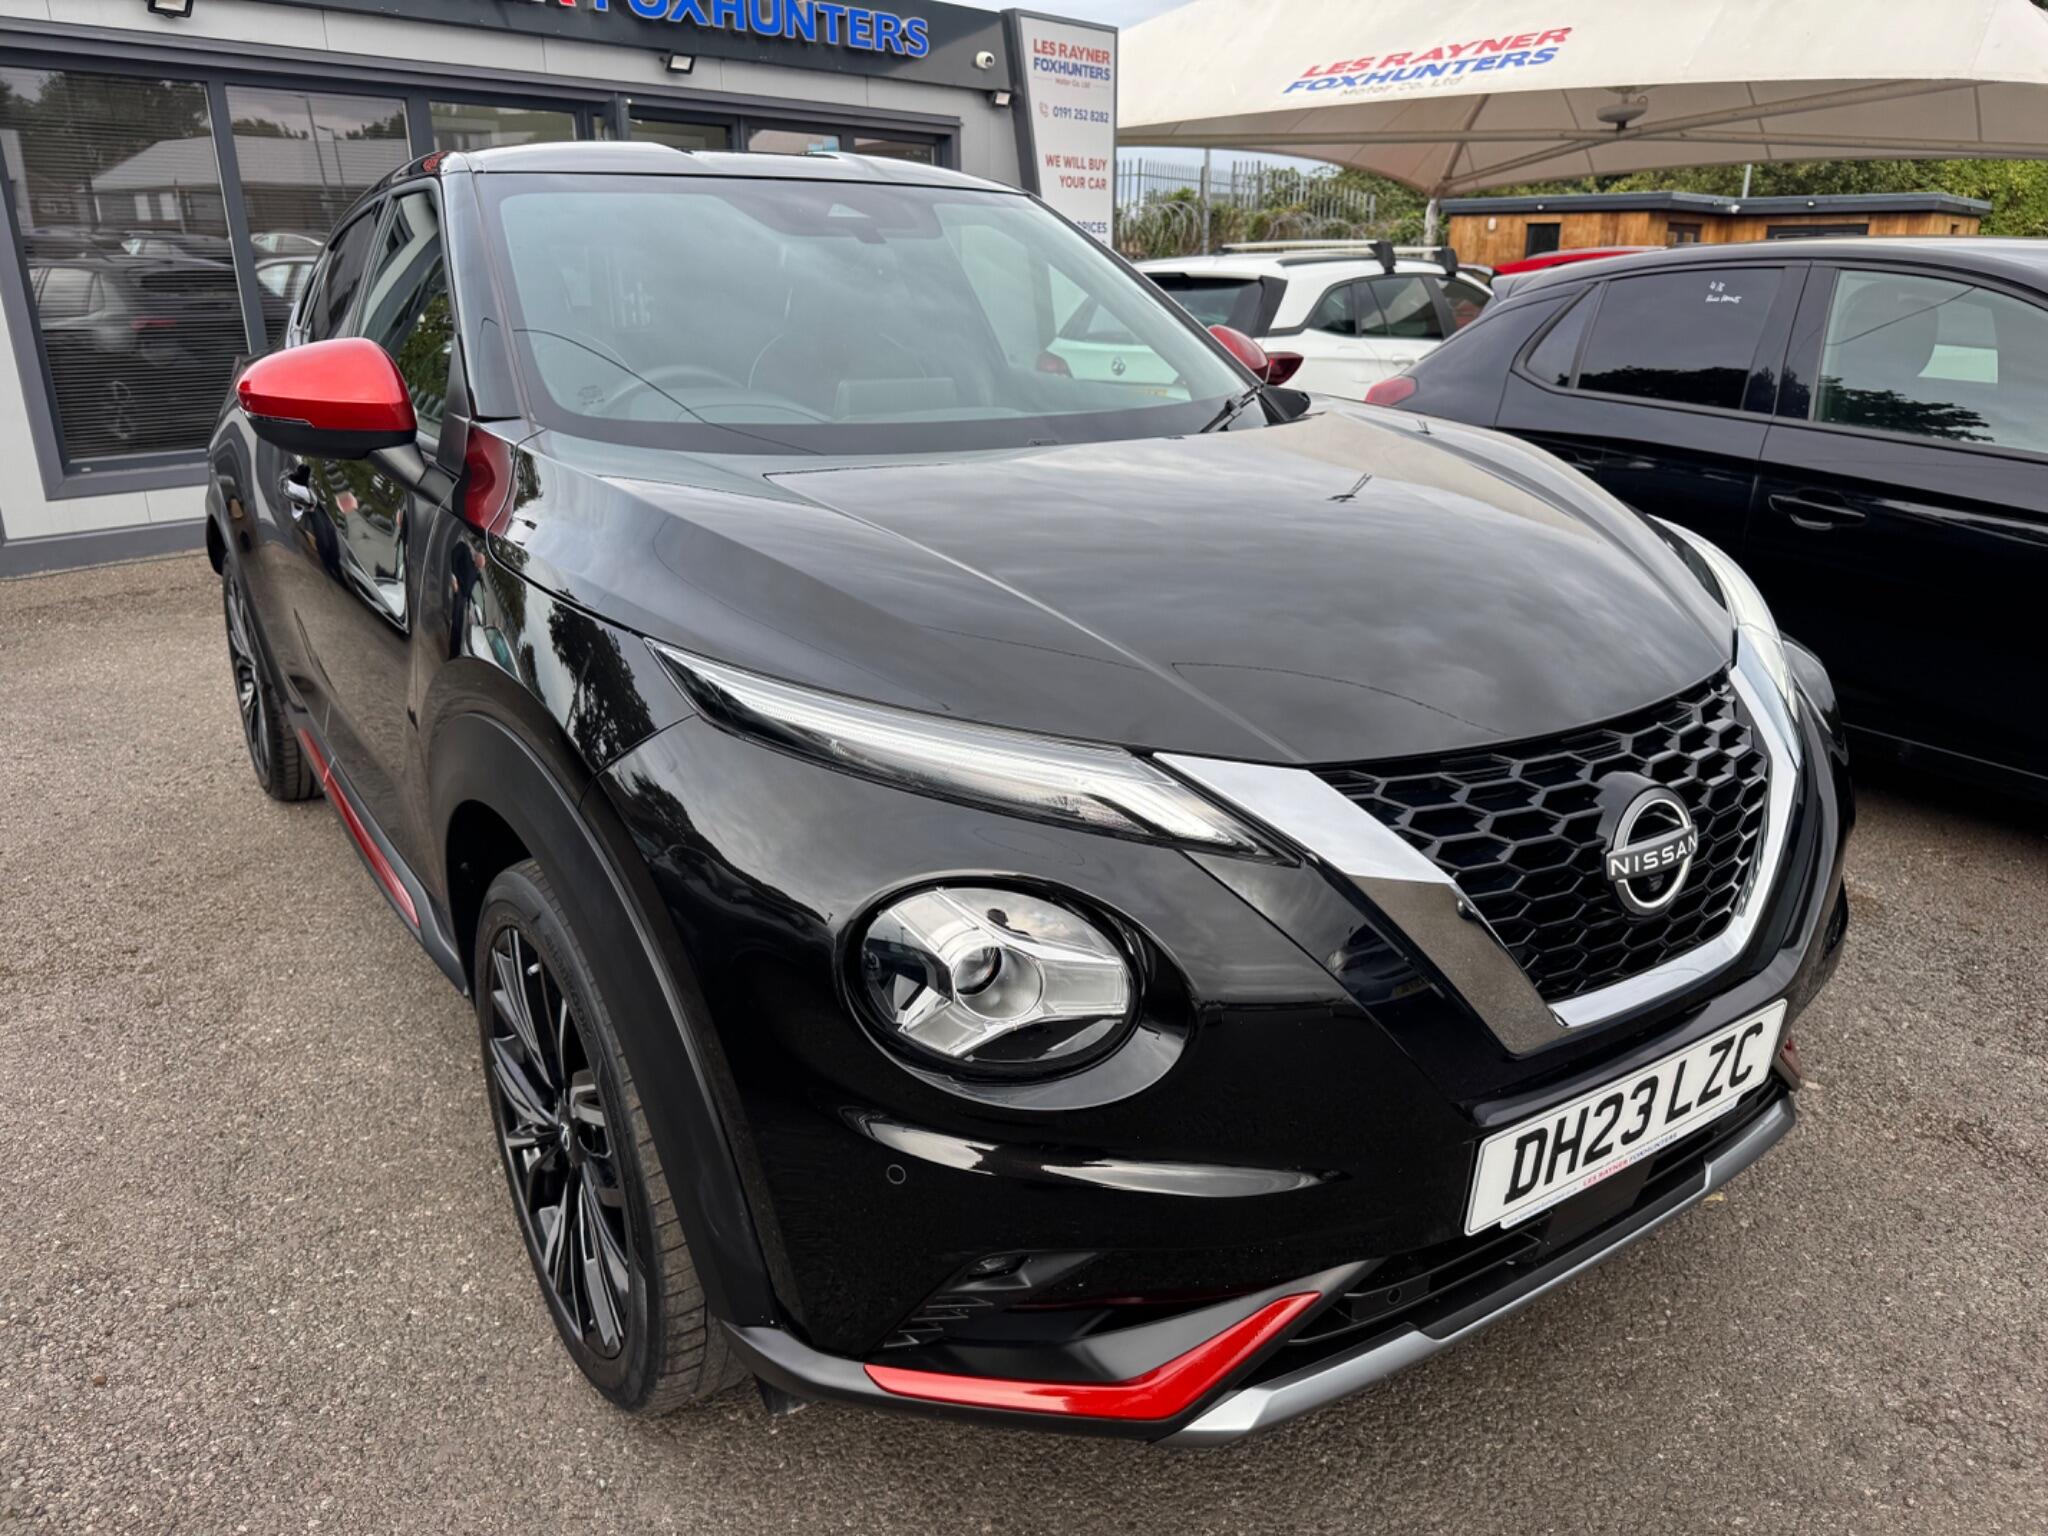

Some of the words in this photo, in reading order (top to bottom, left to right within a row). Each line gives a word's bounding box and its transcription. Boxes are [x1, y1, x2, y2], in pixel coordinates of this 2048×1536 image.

[594, 0, 930, 58] OXHUNTERS
[1033, 38, 1056, 56] LES
[1058, 43, 1110, 65] RAYNER
[1300, 56, 1376, 78] LES
[1377, 27, 1572, 68] RAYNER
[1033, 57, 1111, 81] FOXHUNTERS
[1283, 47, 1559, 94] FOXHUNTERS
[1053, 106, 1072, 119] 0191
[1045, 154, 1061, 168] WE
[1063, 156, 1086, 170] WILL
[1088, 158, 1107, 171] BUY
[1060, 175, 1085, 189] YOUR
[1087, 177, 1106, 190] CAR
[1610, 835, 1696, 876] NISSAN
[1503, 1075, 1658, 1205] DH23
[1664, 1021, 1764, 1125] LZC
